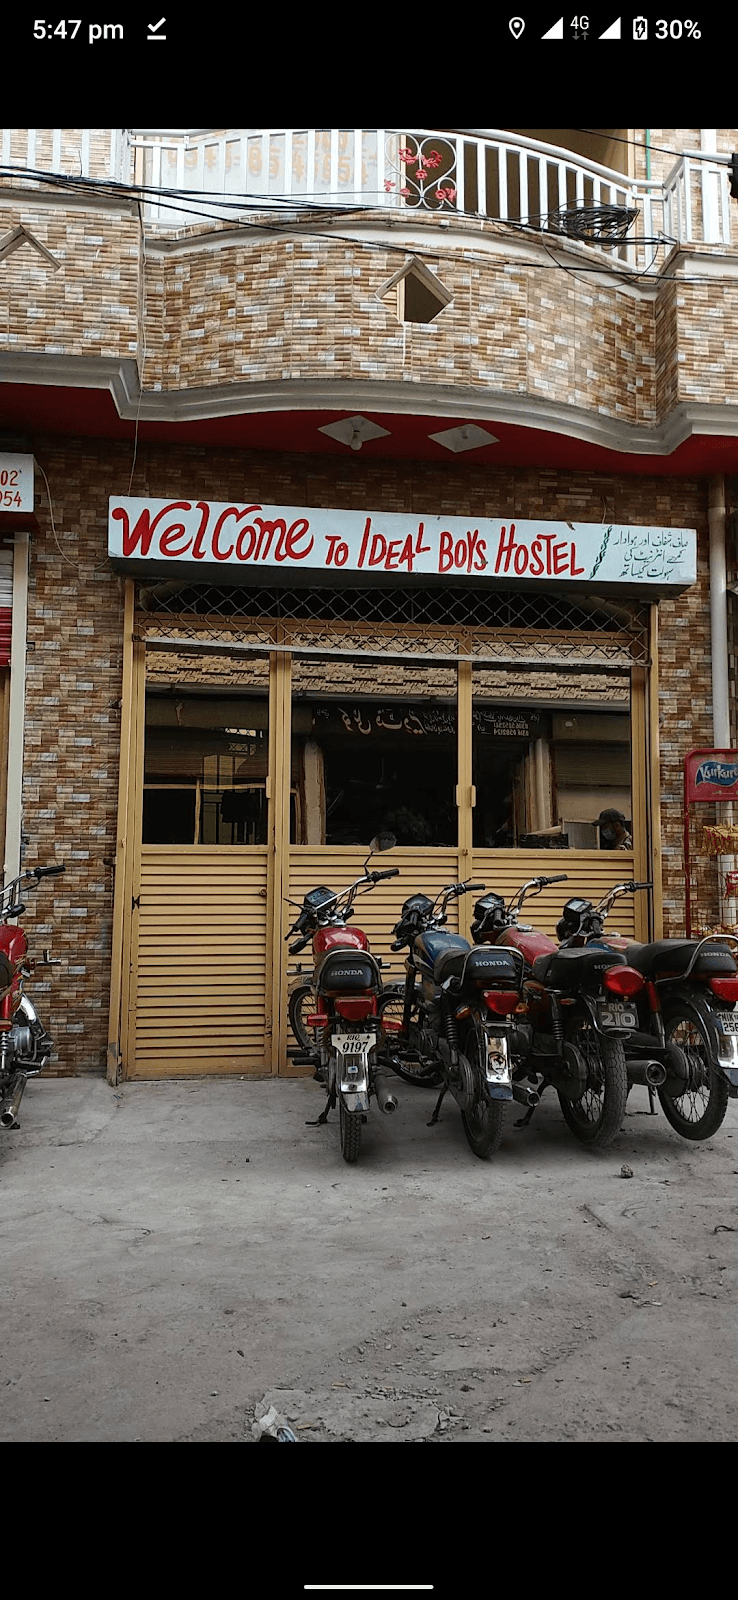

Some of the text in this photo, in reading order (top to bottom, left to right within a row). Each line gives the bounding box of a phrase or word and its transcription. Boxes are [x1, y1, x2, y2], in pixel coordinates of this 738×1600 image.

[357, 517, 430, 571] IDEAL
[438, 524, 489, 574] BOYS
[494, 523, 585, 577] HOSTEL
[601, 1012, 636, 1027] 210
[342, 1041, 369, 1053] 9197
